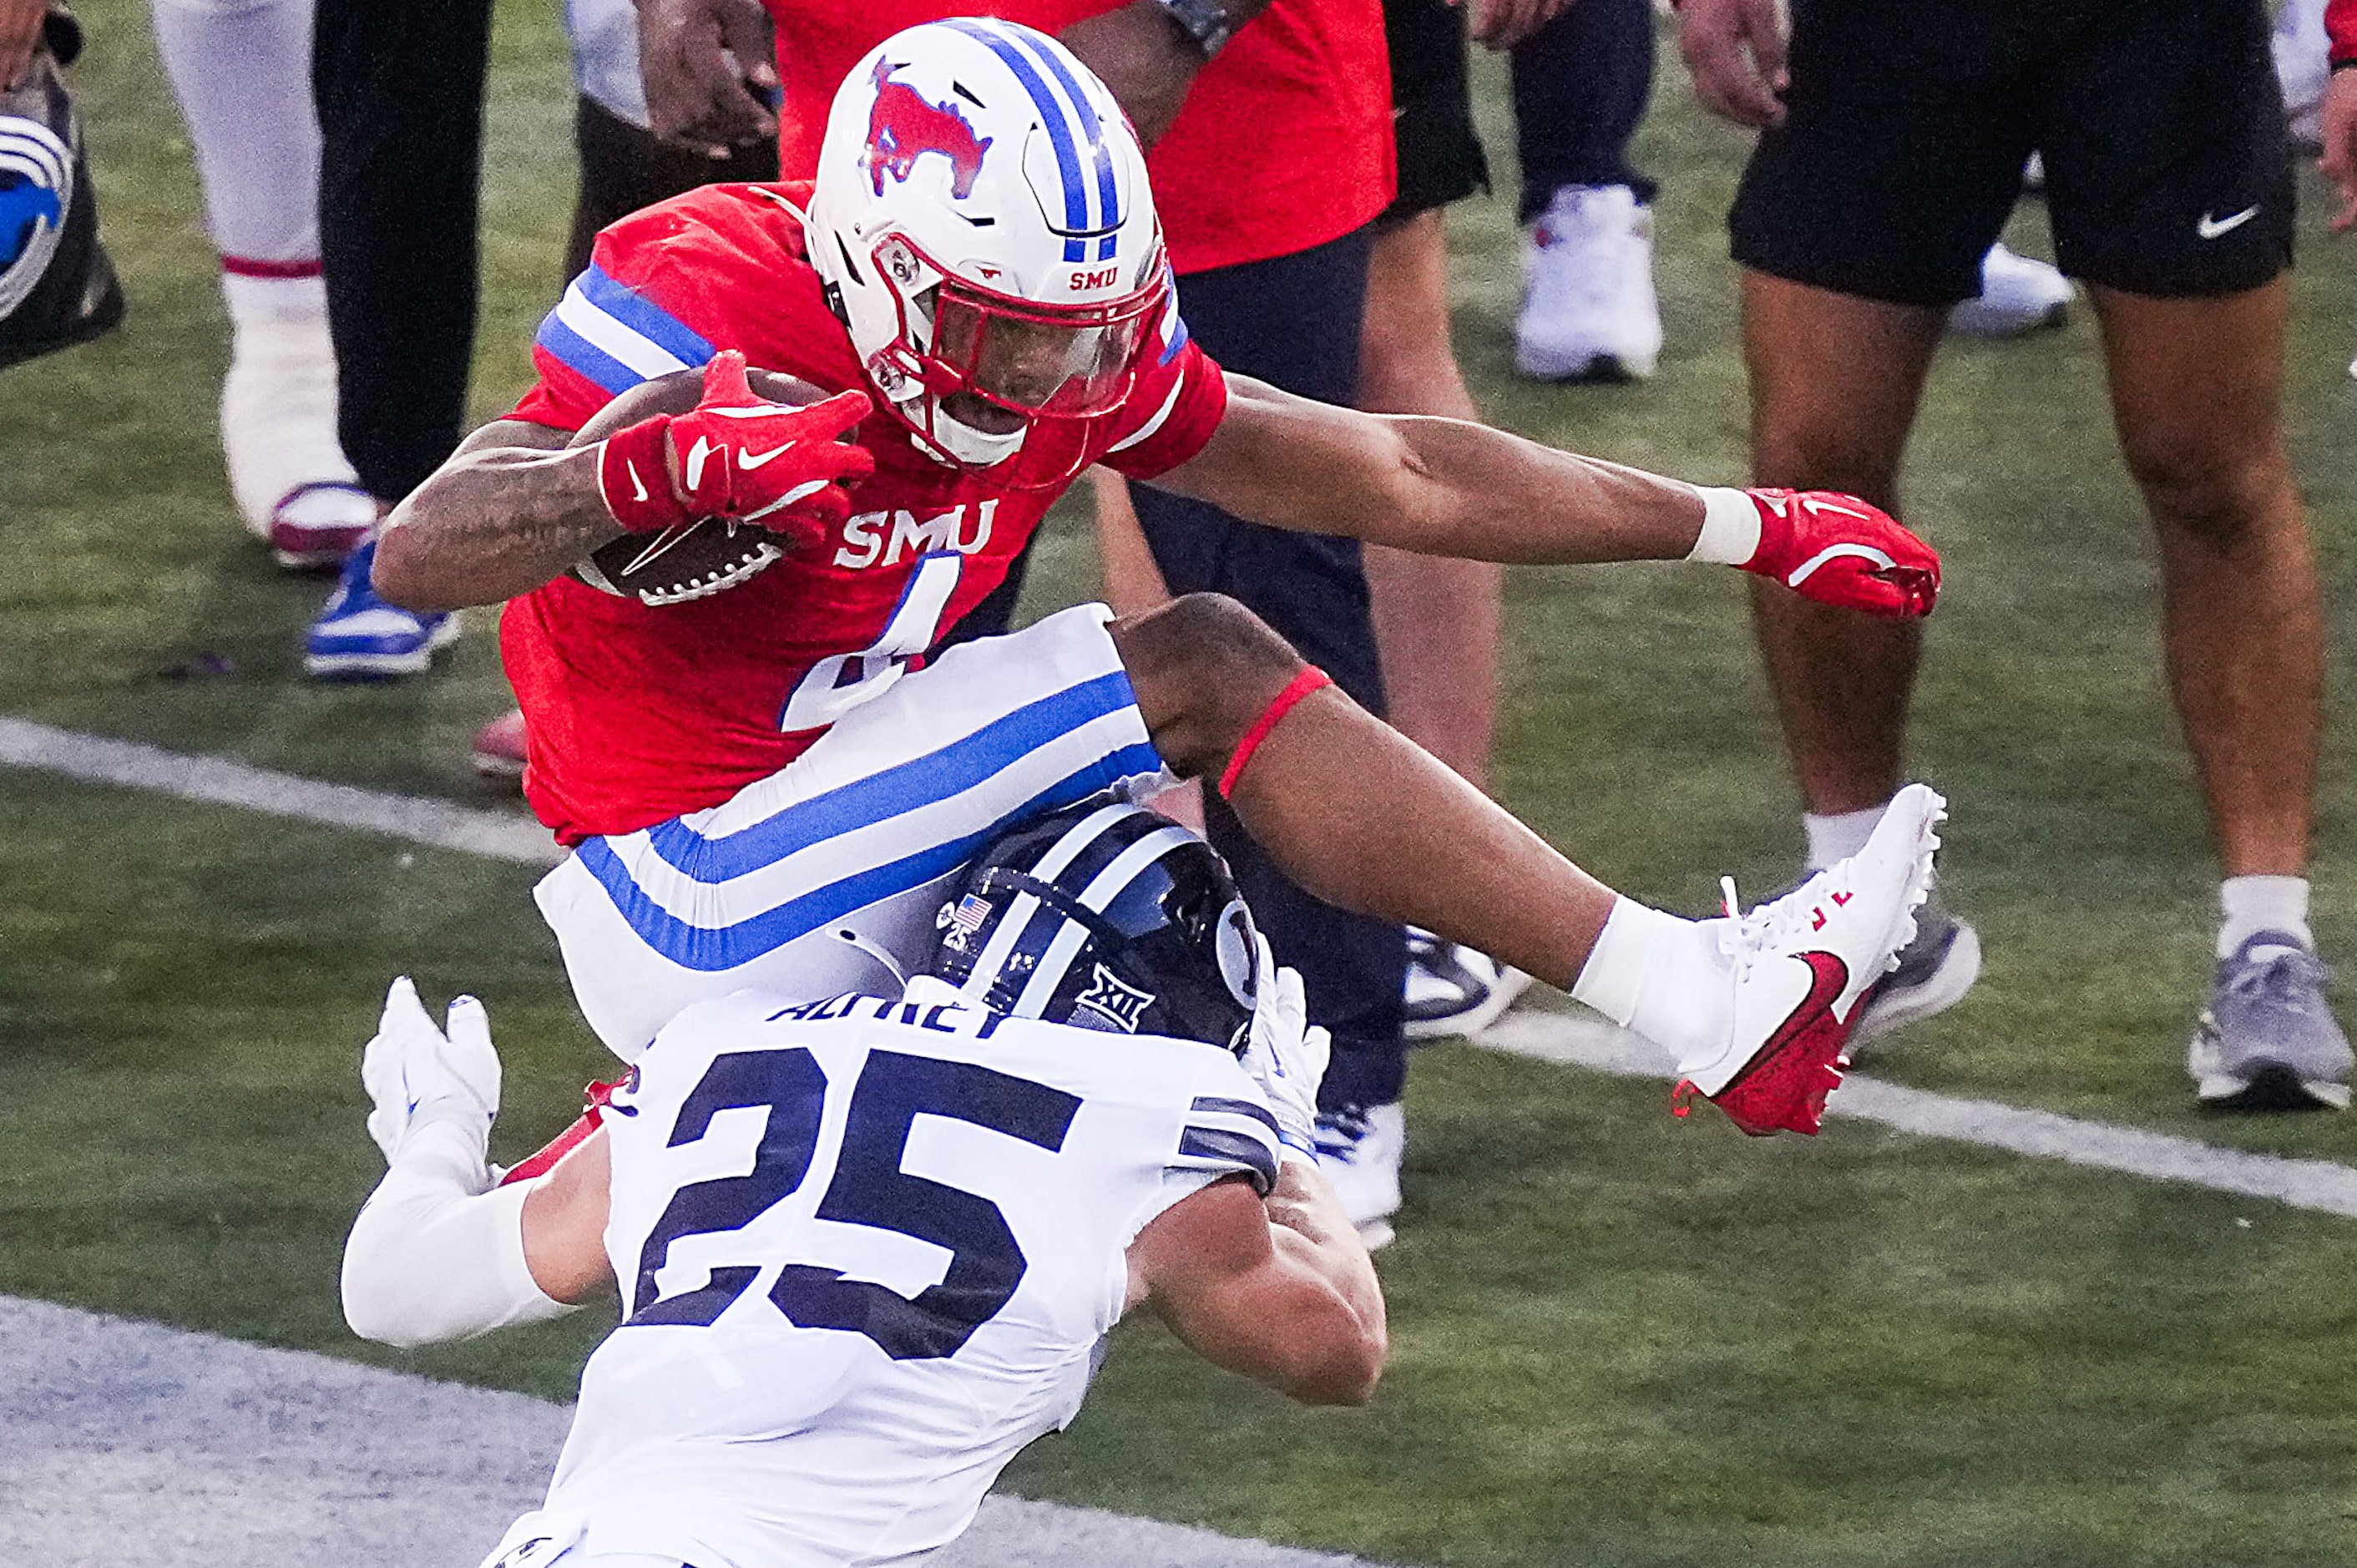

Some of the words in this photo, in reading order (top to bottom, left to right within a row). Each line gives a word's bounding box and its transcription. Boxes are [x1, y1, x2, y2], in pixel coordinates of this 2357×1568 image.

[1070, 266, 1118, 291] SMU
[832, 498, 999, 569] SMU
[943, 922, 972, 951] 25
[622, 1047, 1084, 1361] 25
